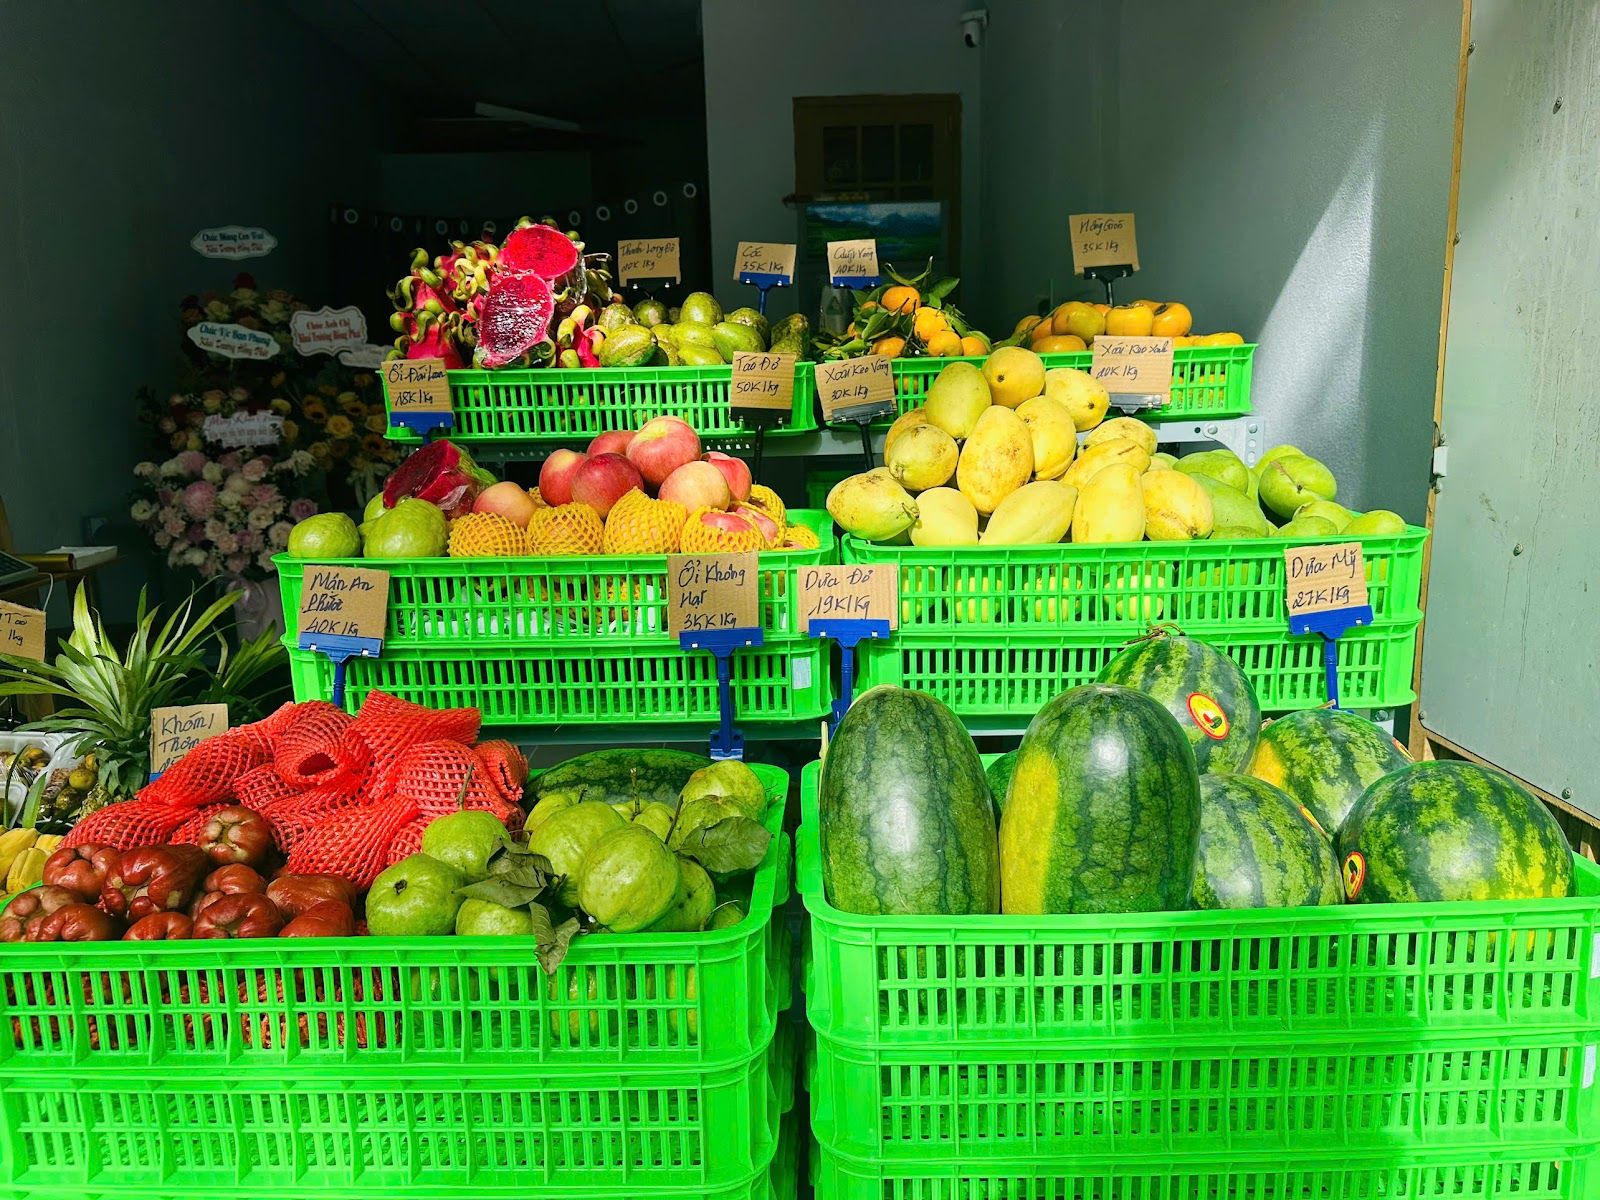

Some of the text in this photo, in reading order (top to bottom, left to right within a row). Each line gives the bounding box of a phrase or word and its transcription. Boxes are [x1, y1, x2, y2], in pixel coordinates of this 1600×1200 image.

[759, 356, 781, 370] Đỏ
[852, 364, 869, 376] Keo
[736, 381, 761, 394] 50K
[395, 391, 416, 406] 18K
[1332, 548, 1358, 578] Mỹ
[678, 559, 746, 587] Ổi Không
[846, 568, 874, 584] Đỏ
[349, 576, 374, 591] An
[680, 590, 708, 609] Hạt
[808, 596, 848, 616] 19K
[1292, 589, 1328, 609] 27K
[306, 617, 340, 633] 40K
[684, 613, 716, 630] 35K
